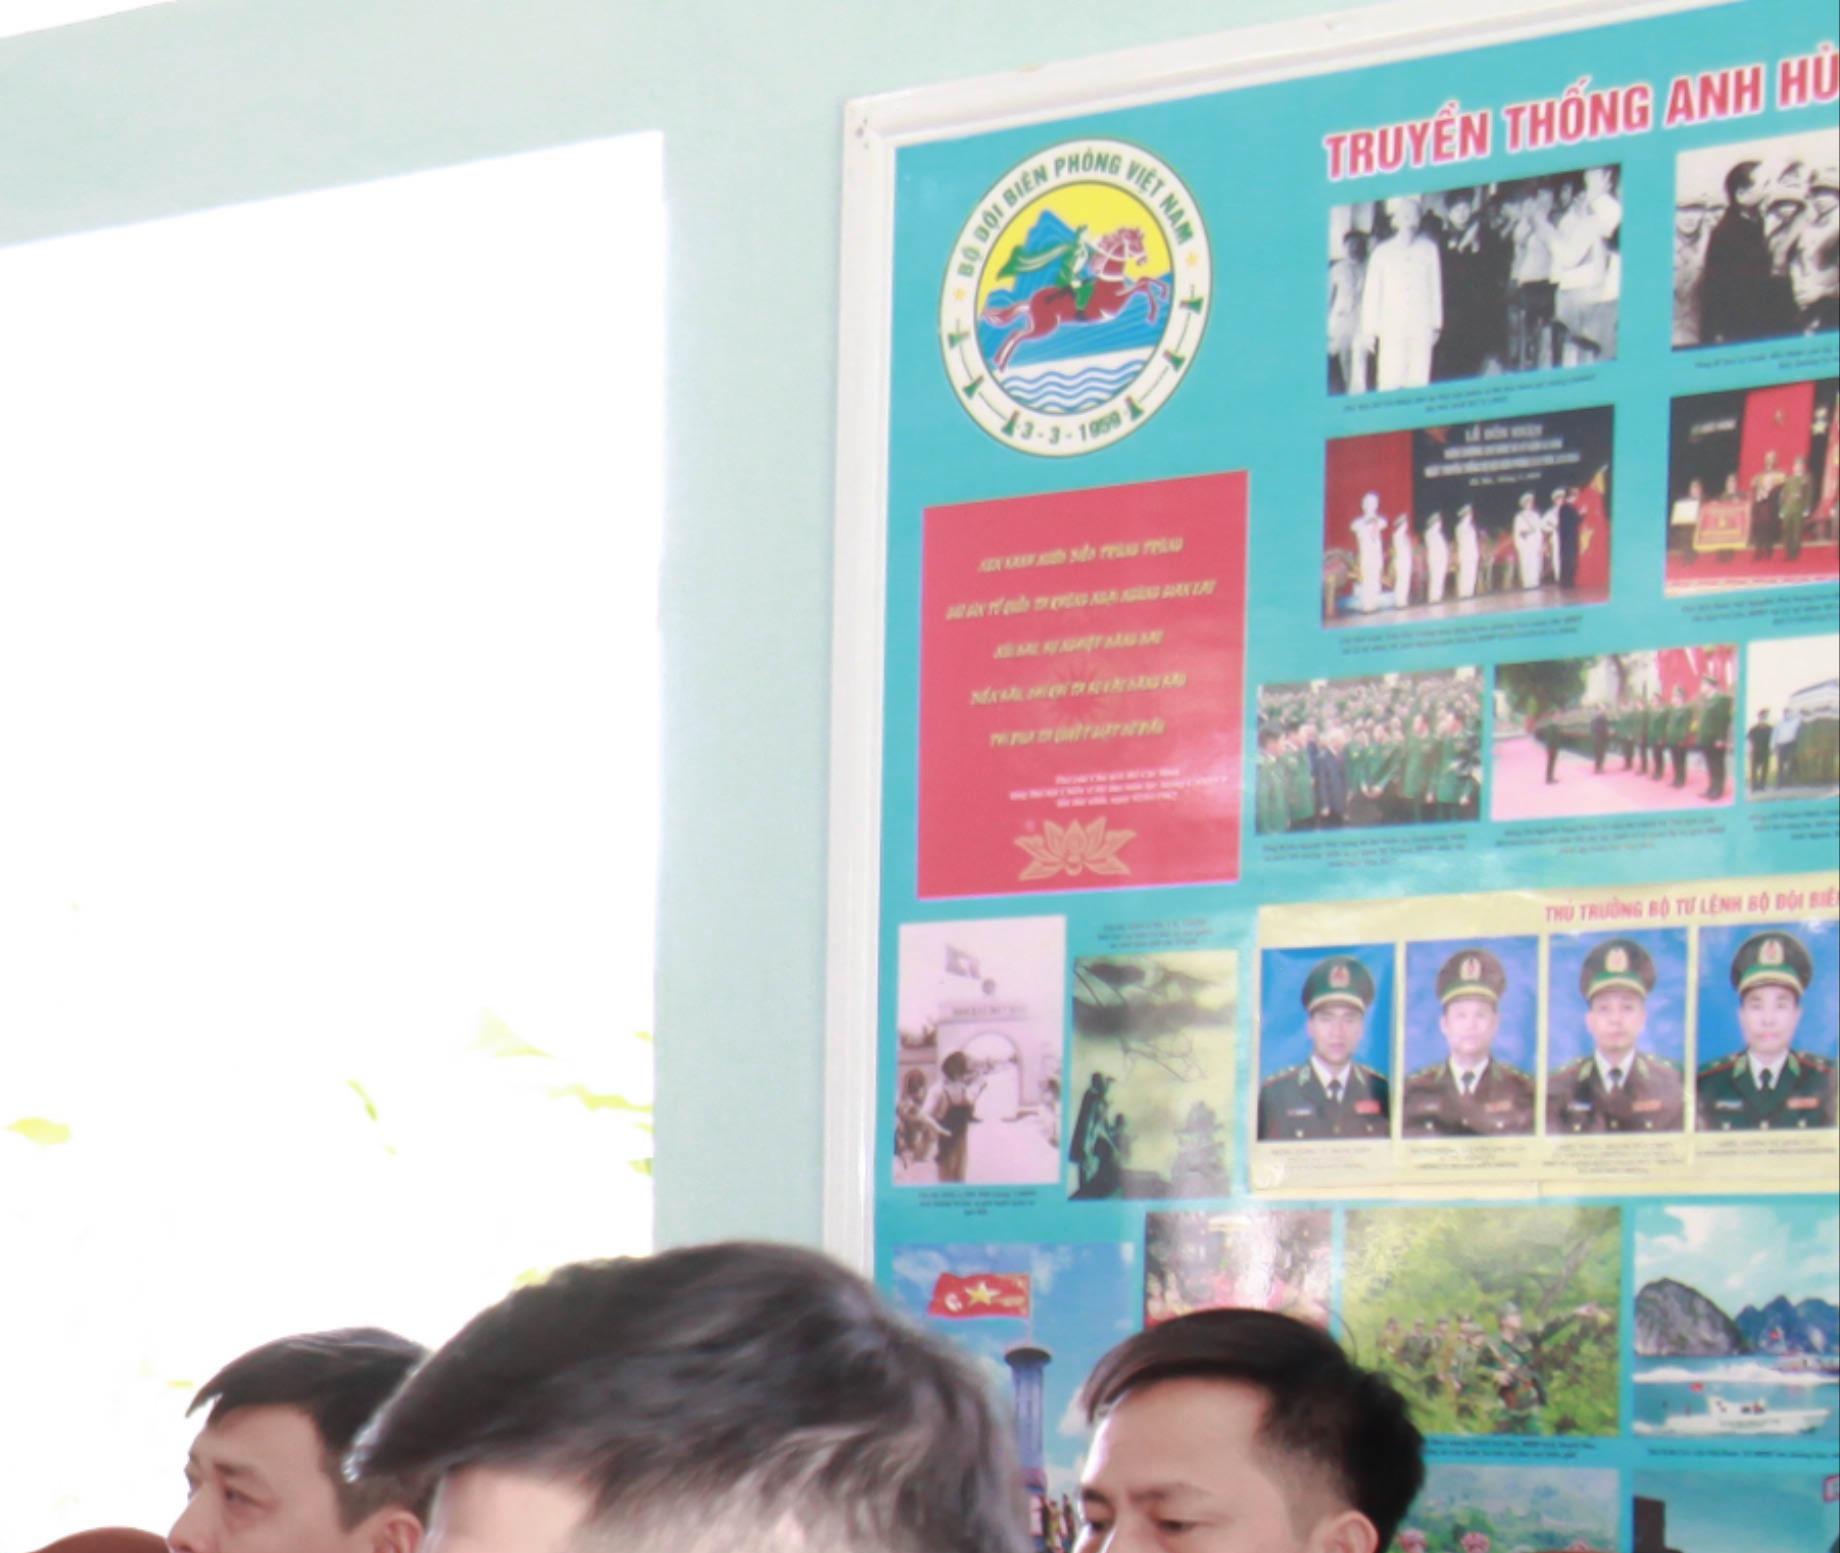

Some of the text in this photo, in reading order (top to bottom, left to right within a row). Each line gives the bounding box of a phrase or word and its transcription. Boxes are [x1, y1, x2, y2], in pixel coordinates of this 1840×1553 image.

[1324, 98, 1490, 181] TRUYỀN
[1503, 72, 1652, 153] THỐNG
[1663, 63, 1764, 129] ANH
[1002, 164, 1049, 209] BIÊN
[1053, 147, 1123, 178] PHÒNG
[1125, 160, 1166, 199] VIỆT
[1158, 192, 1195, 246] NAM
